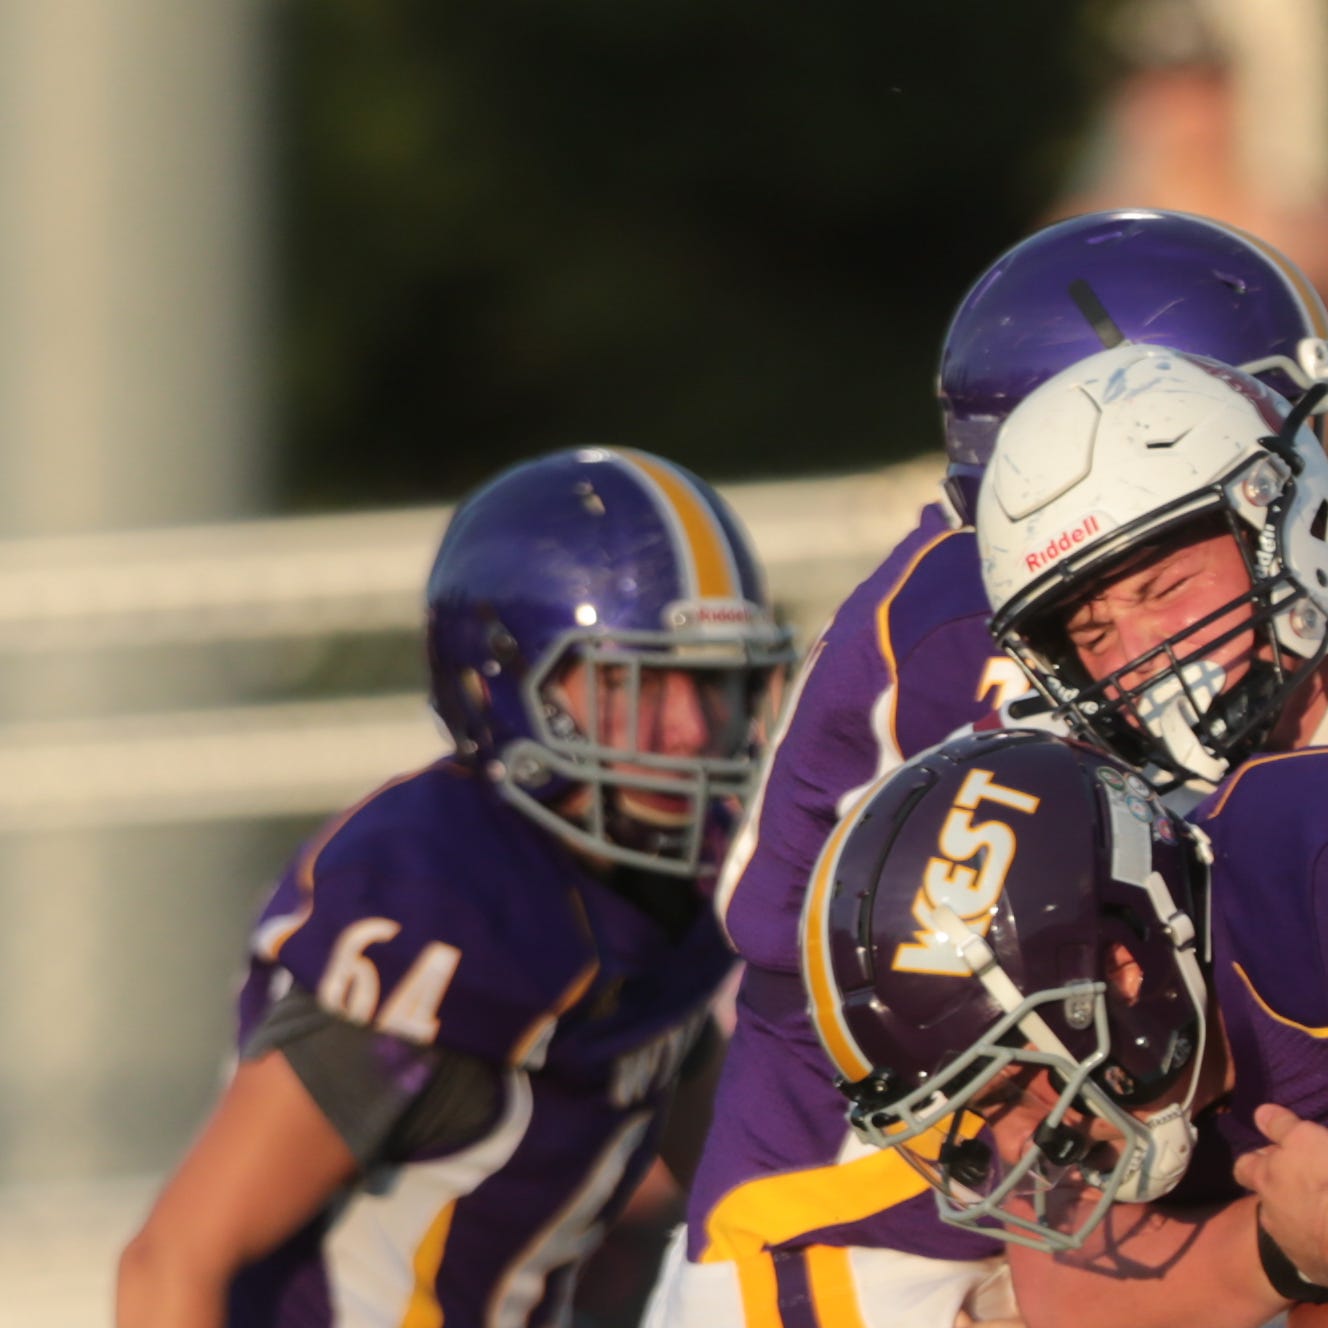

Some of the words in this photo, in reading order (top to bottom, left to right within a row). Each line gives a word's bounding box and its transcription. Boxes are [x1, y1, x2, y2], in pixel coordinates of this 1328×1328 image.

[1025, 515, 1099, 573] Riddell
[891, 767, 1041, 977] WEST
[317, 917, 462, 1046] 64
